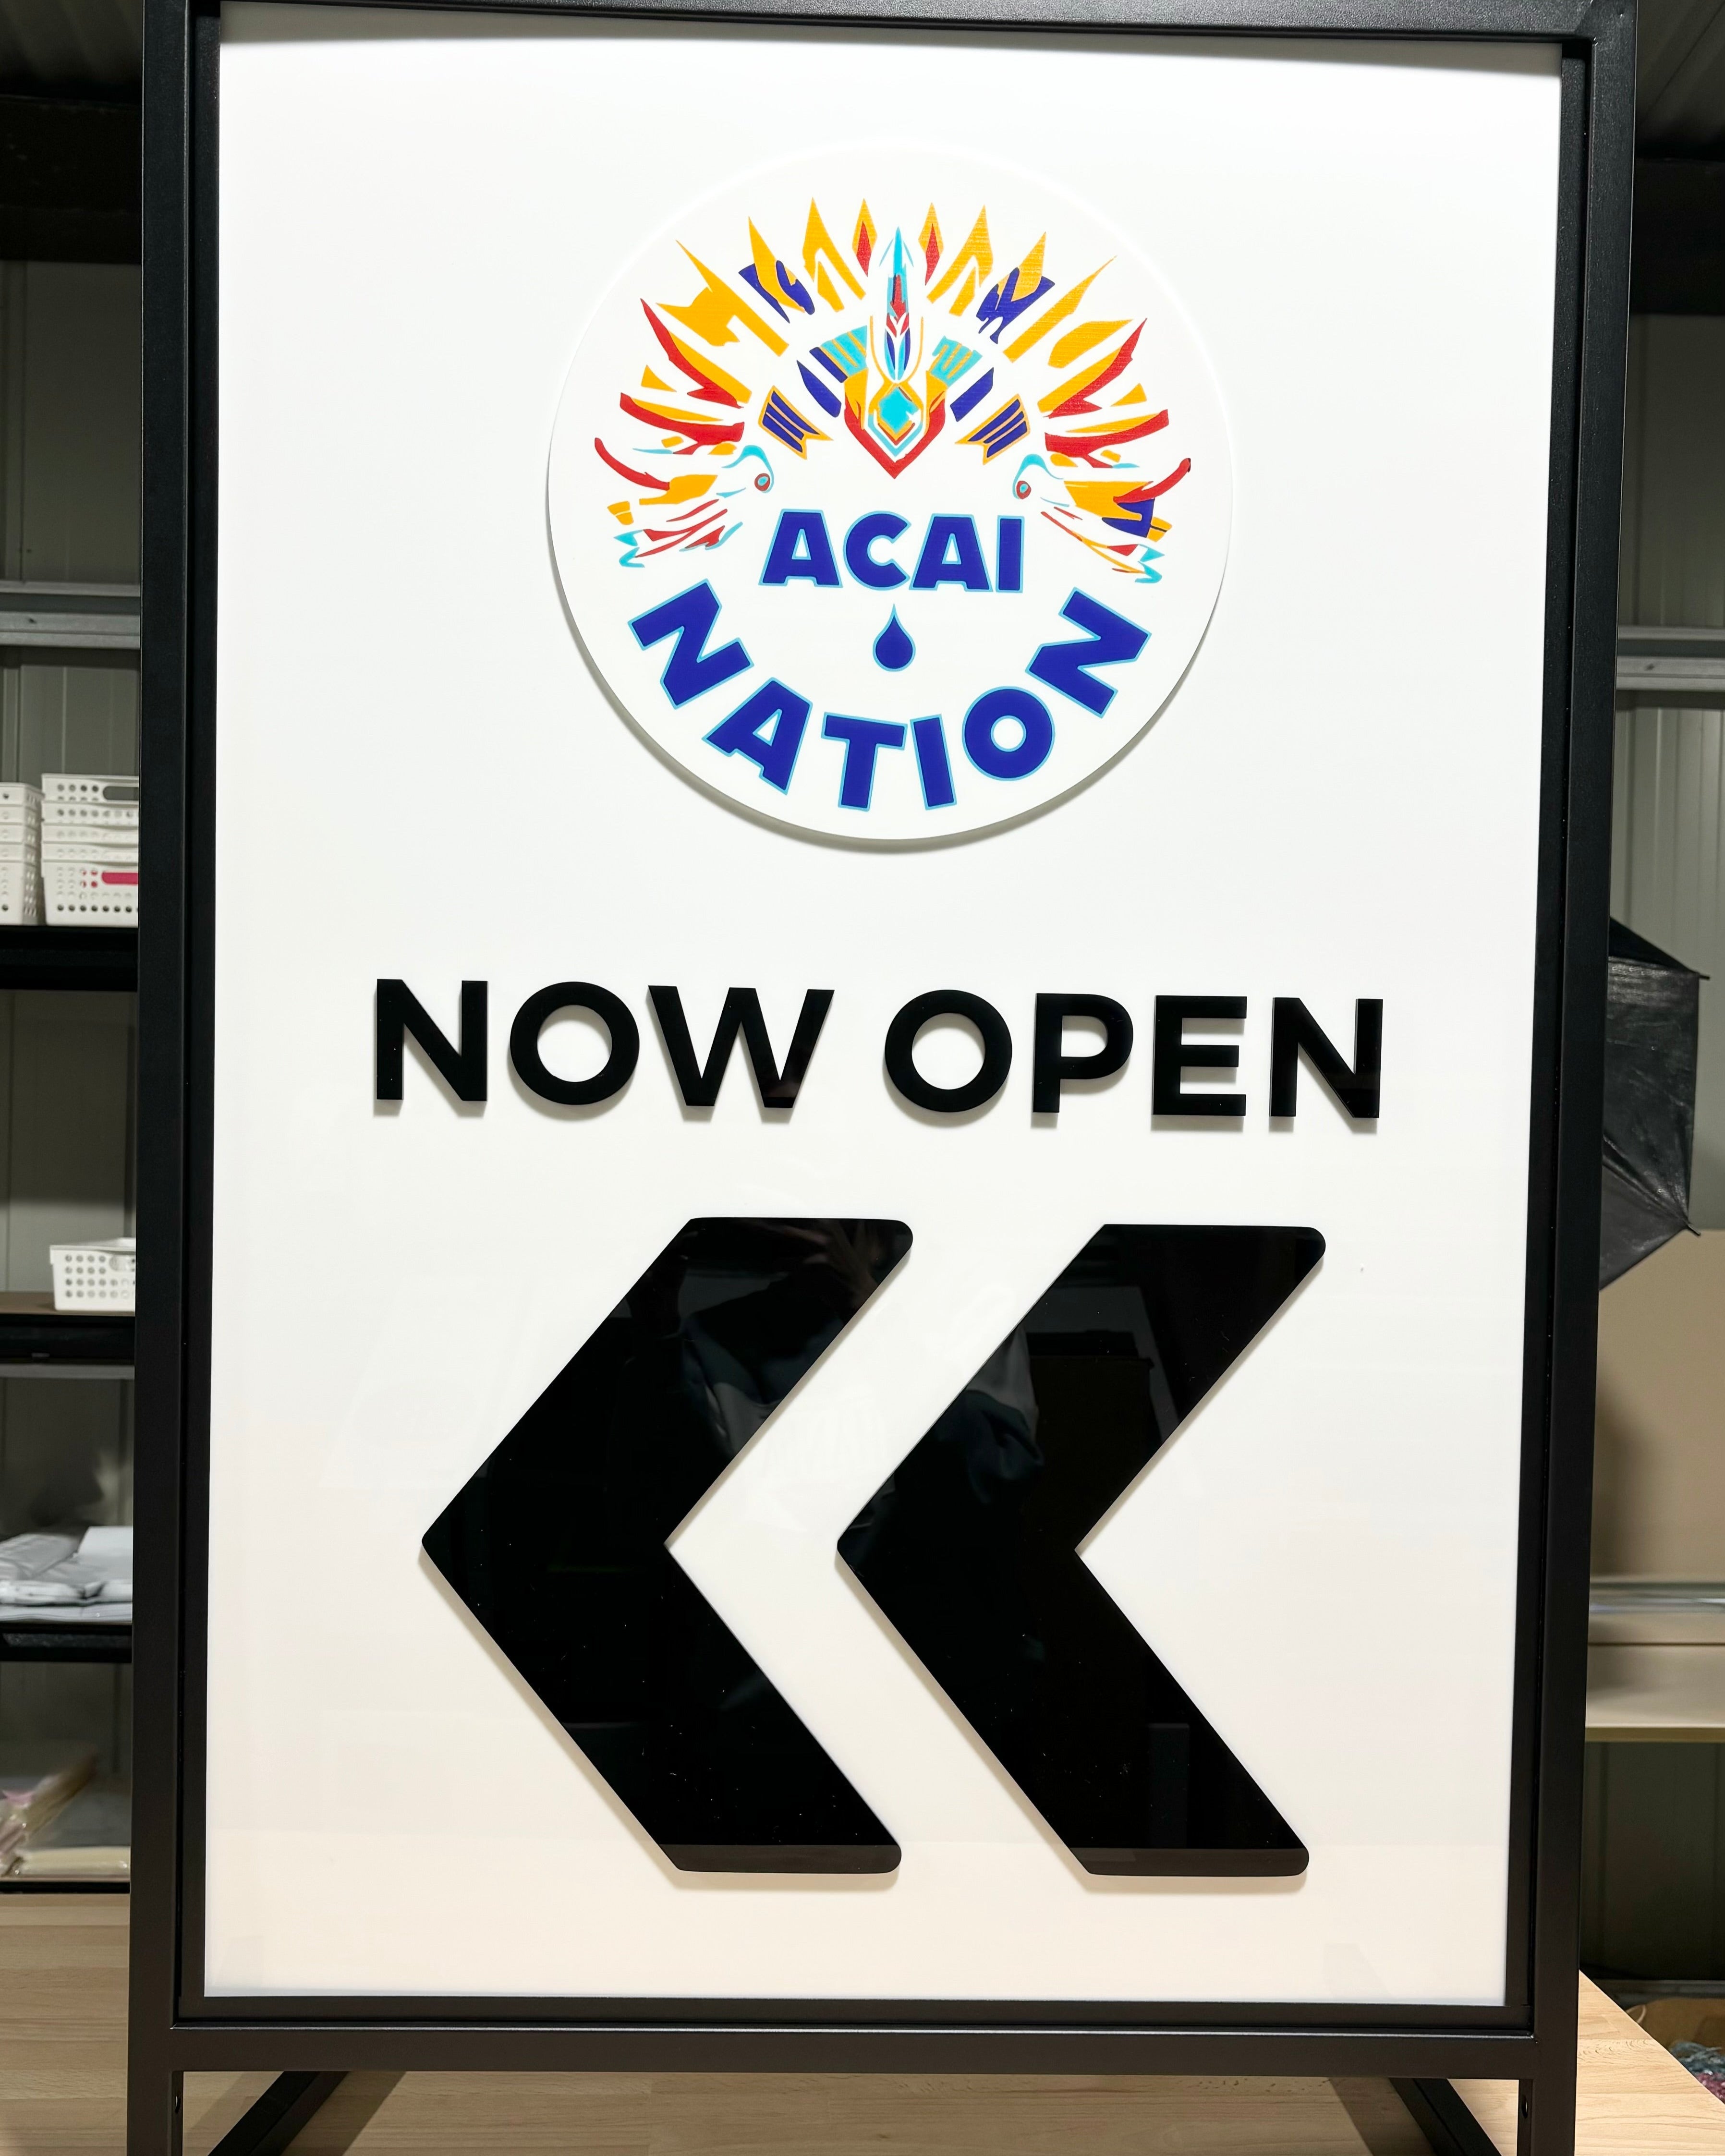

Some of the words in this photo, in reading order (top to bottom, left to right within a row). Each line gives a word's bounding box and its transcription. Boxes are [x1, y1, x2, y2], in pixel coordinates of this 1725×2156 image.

[759, 509, 1024, 593] ACAI
[629, 579, 1151, 811] NATION
[377, 979, 834, 1109] NOW
[885, 990, 1383, 1119] OPEN
